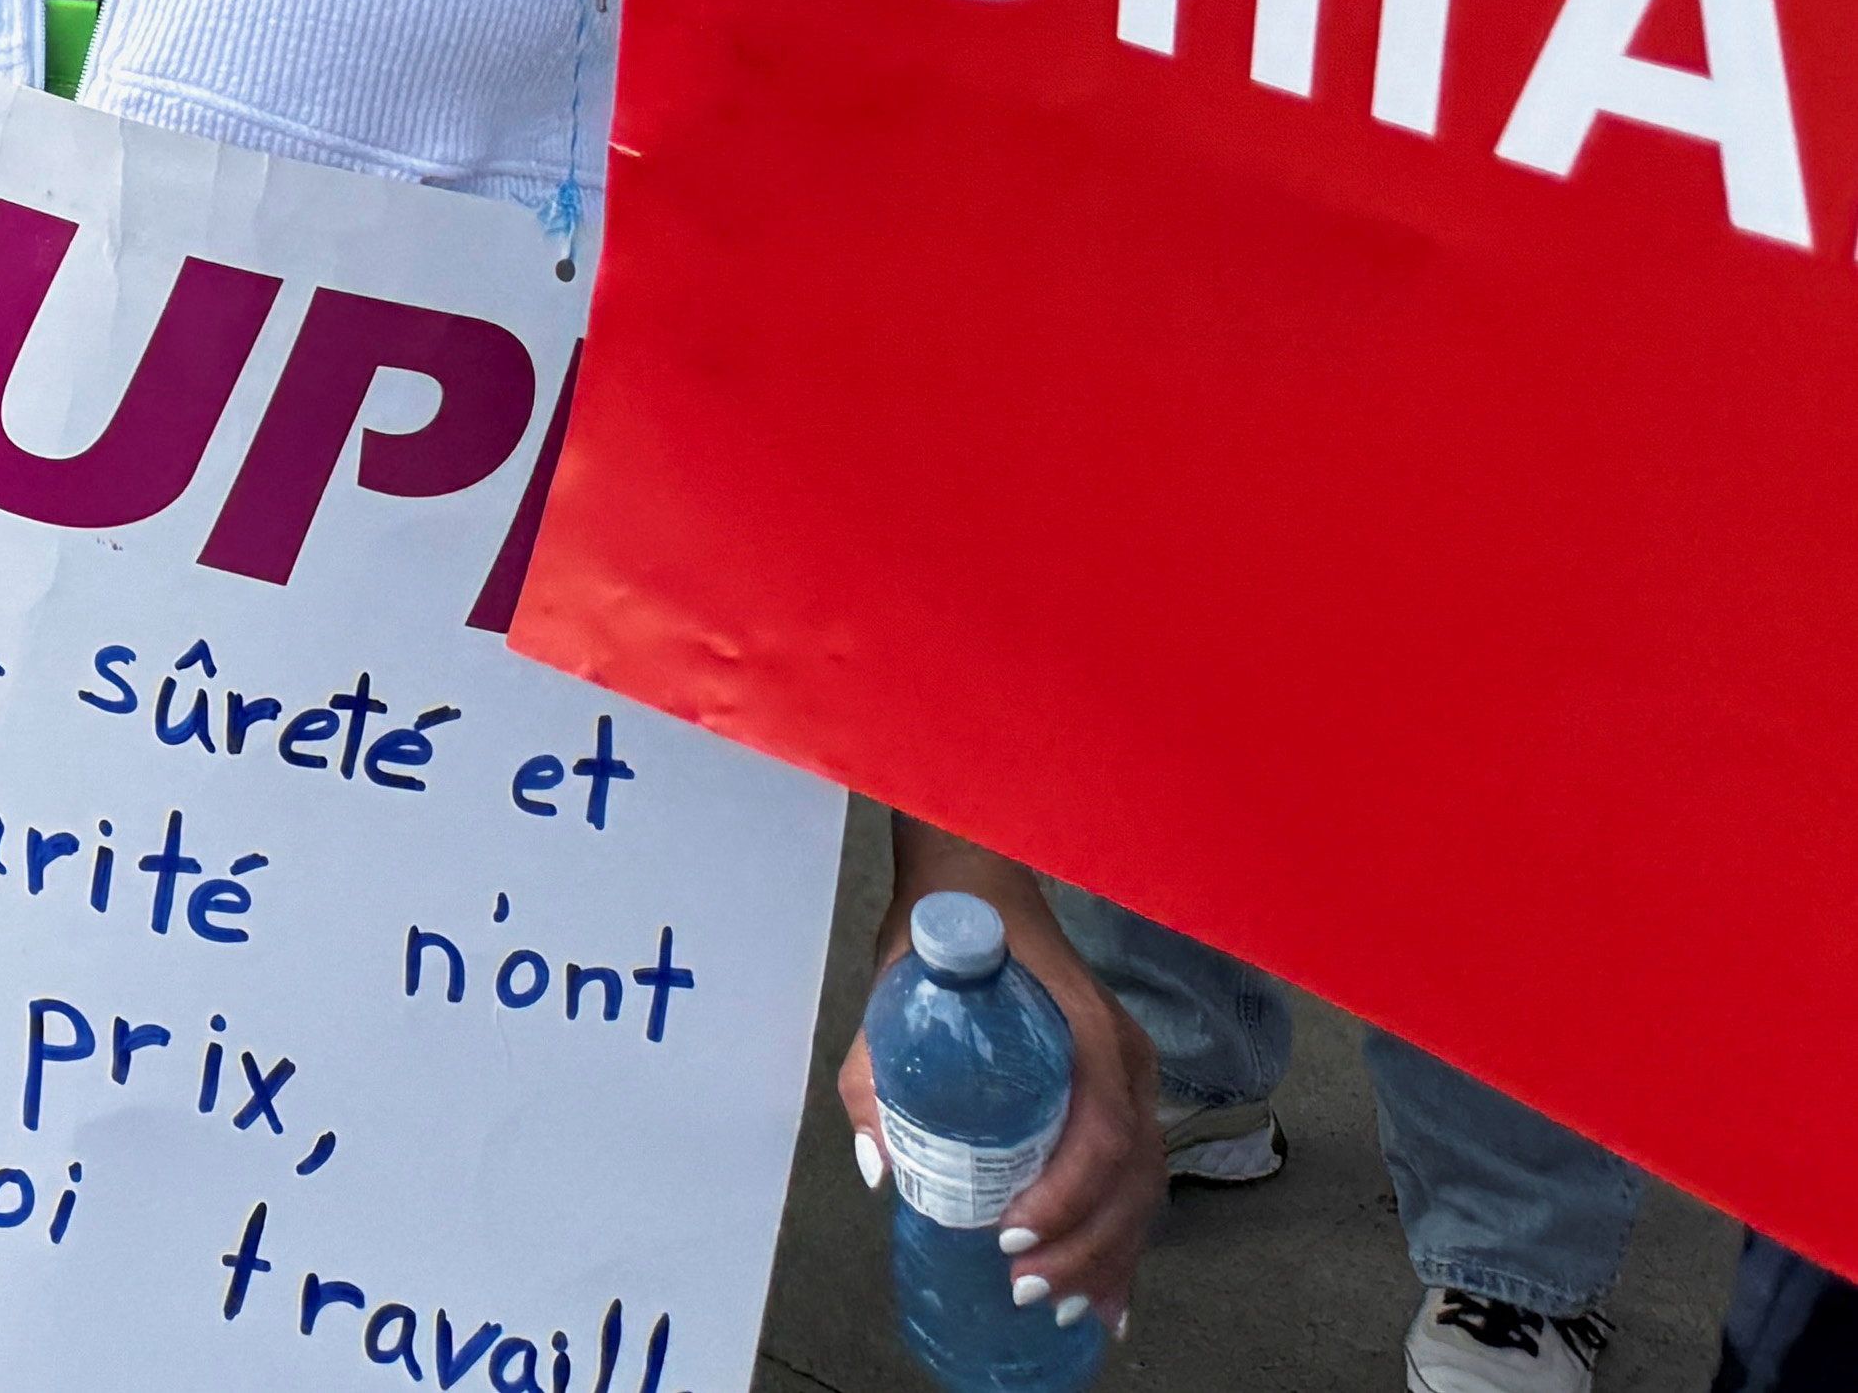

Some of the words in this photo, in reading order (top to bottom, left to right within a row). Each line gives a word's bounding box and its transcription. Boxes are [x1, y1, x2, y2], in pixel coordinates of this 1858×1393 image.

[79, 638, 464, 793] sûreté
[511, 714, 636, 833] et
[405, 893, 696, 1045] n'ont
[25, 997, 341, 1177] prix,
[220, 1201, 691, 1393] travaill
